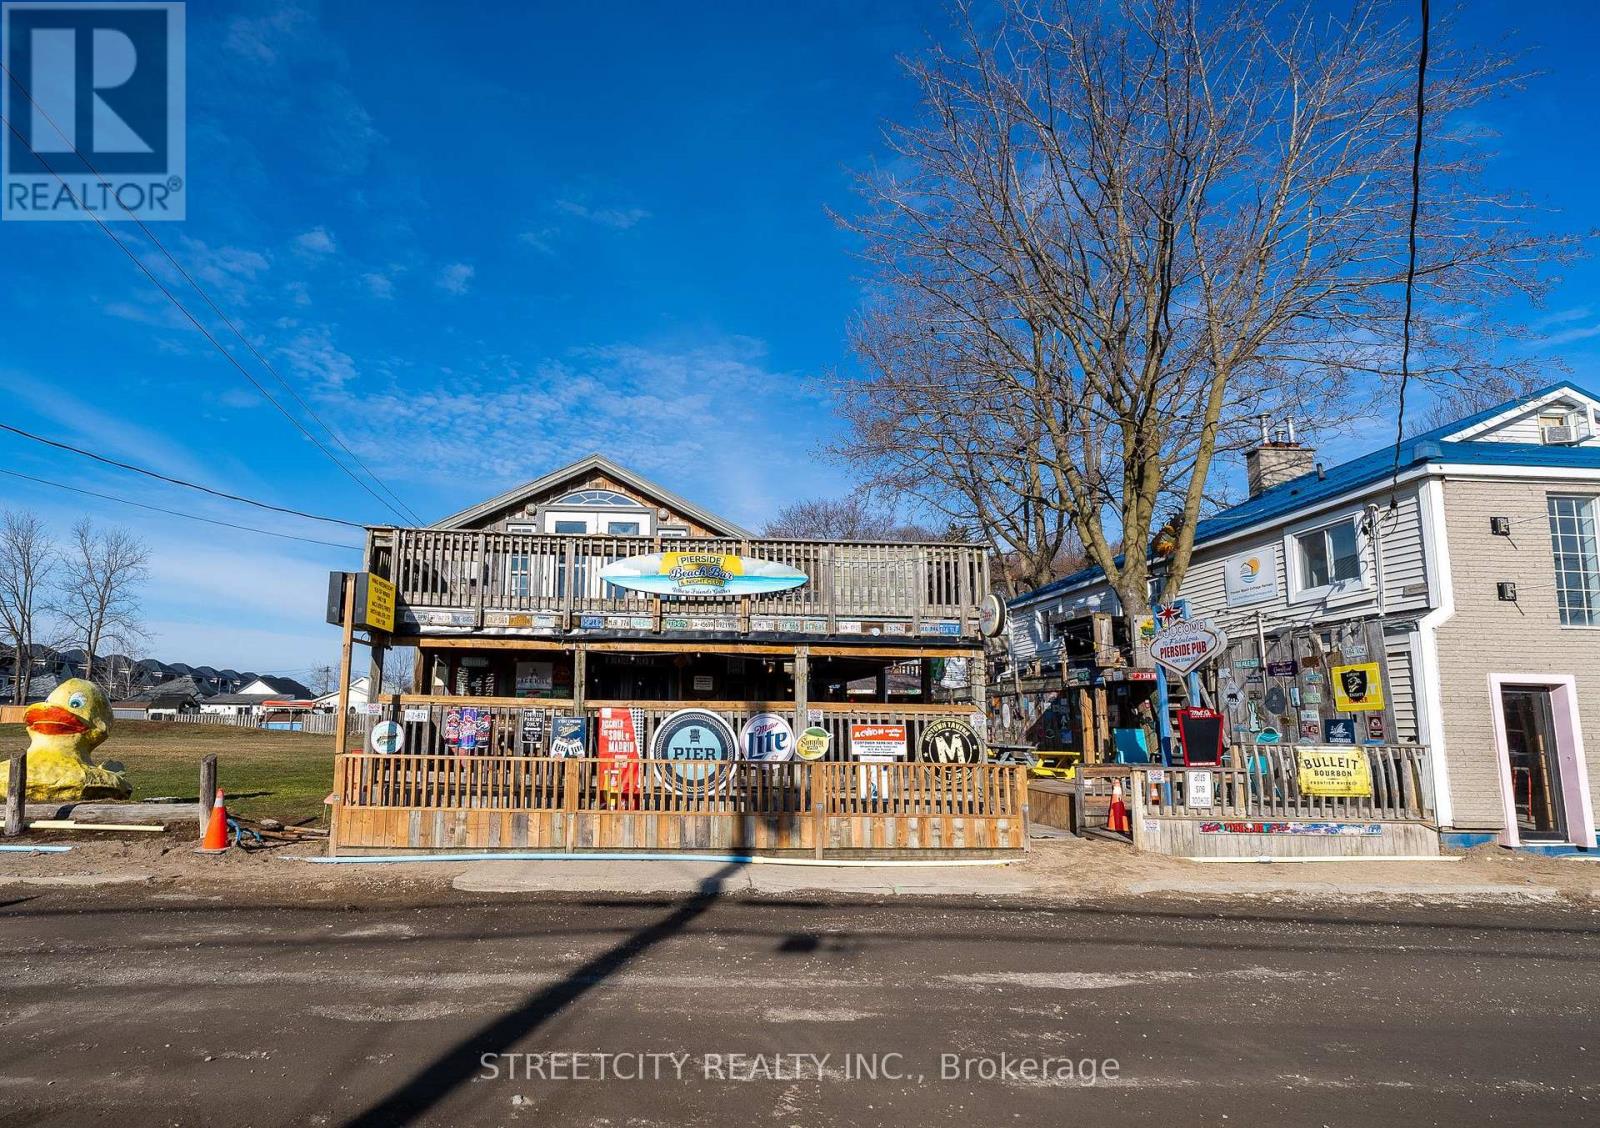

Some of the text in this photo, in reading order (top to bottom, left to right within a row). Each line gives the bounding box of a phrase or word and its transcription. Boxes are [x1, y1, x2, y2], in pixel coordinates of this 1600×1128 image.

[680, 555, 721, 564] PIERSIDE
[669, 565, 733, 580] Beach Bar
[1160, 641, 1207, 659] PIERSIDE PUB
[755, 721, 779, 735] Miller
[924, 721, 971, 742] MOTOWN TAVERN
[608, 730, 625, 741] SOUL
[608, 742, 635, 753] MADRID
[747, 730, 788, 760] Lite
[935, 734, 966, 764] M
[673, 747, 716, 760] PIER
[1304, 756, 1359, 770] BULLEIT
[1314, 769, 1352, 777] BOURBON
